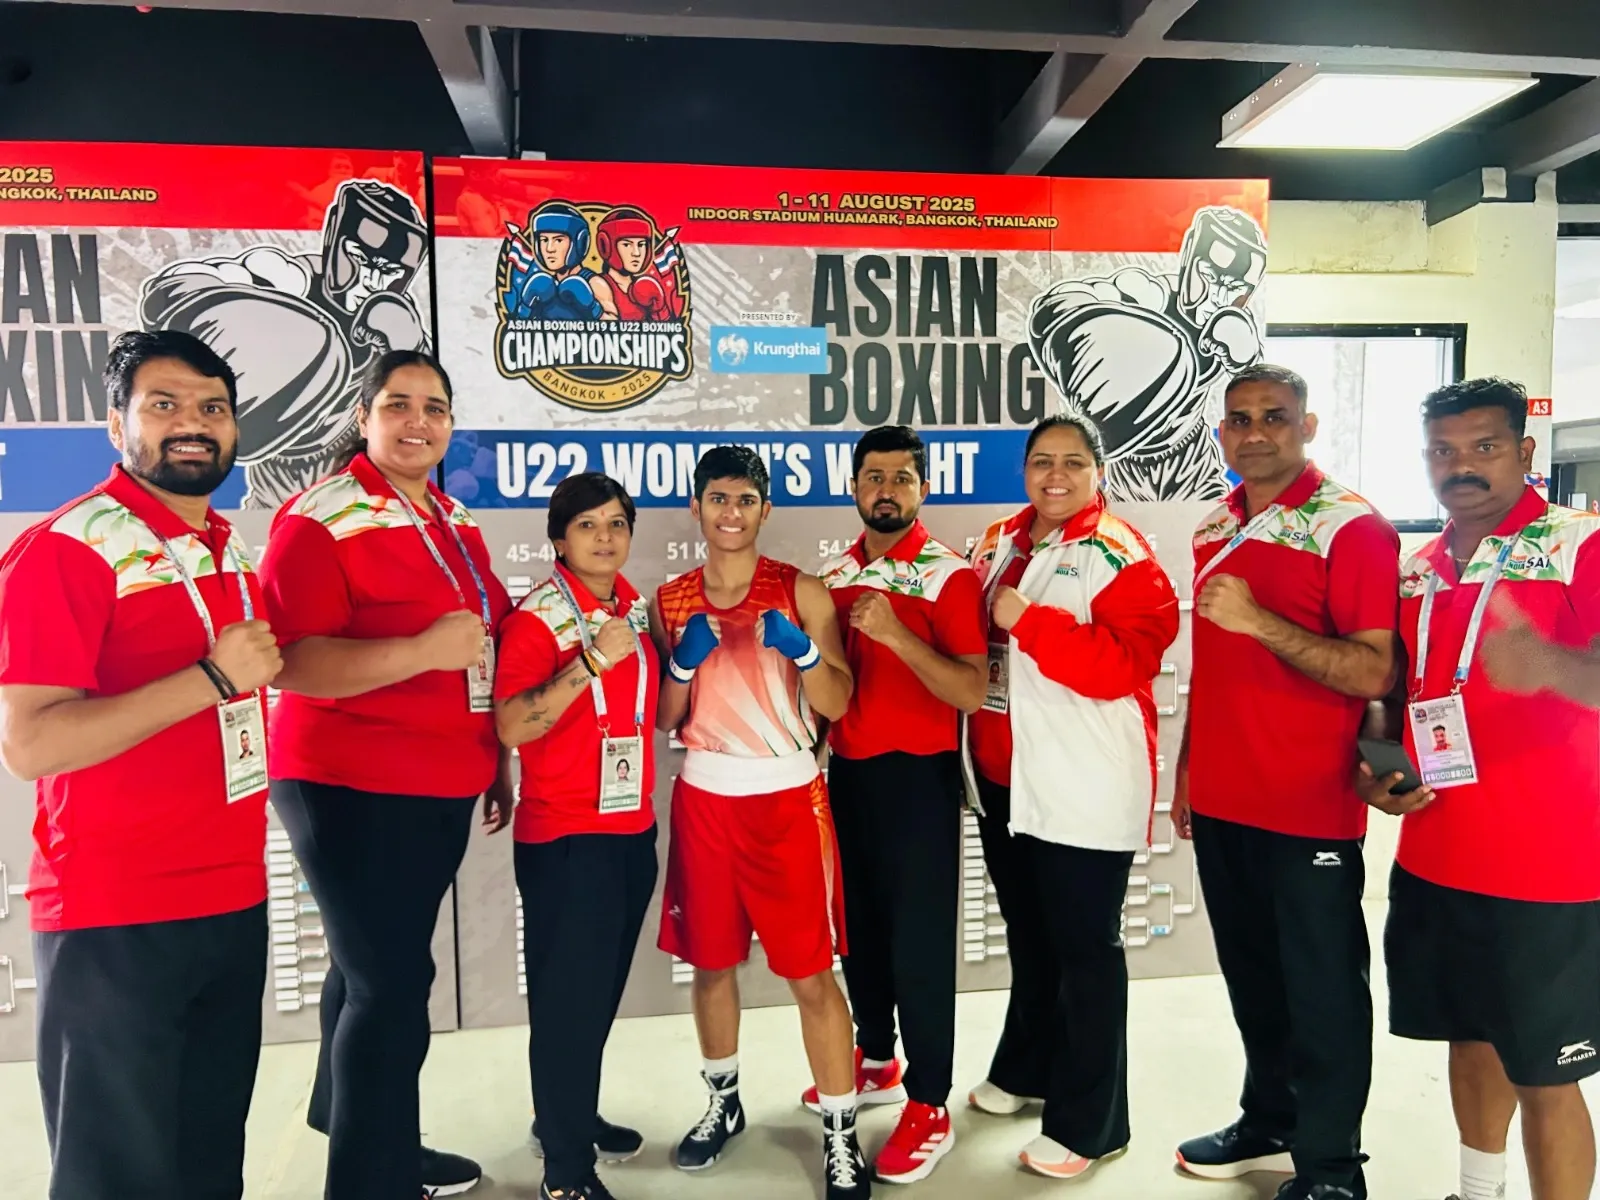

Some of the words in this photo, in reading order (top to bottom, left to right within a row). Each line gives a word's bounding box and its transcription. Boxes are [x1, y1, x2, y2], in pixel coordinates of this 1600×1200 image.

[0, 168, 53, 183] 2025
[66, 188, 157, 201] THAILAND
[778, 192, 788, 207] 1
[808, 193, 829, 208] 11
[840, 194, 925, 210] AUGUST
[930, 197, 975, 211] 2025
[688, 208, 749, 220] INDOOR
[753, 210, 820, 222] STADIUM
[824, 212, 902, 225] HUAMARK,
[906, 214, 982, 227] BANGKOK,
[985, 216, 1058, 228] THAILAND
[2, 234, 101, 323] AN
[809, 254, 998, 337] ASIAN
[508, 321, 541, 331] ASIAN
[544, 322, 584, 331] BOXING
[587, 323, 607, 332] U19
[610, 323, 618, 331] &
[620, 323, 640, 332] U22
[643, 324, 682, 332] BOXING
[742, 313, 784, 321] PRESENTED
[787, 313, 797, 321] BY
[503, 331, 685, 372] CHAMPIONSHIPS
[754, 341, 821, 358] Krungthai
[543, 372, 605, 400] BANGKOK
[622, 372, 651, 396] 2025
[810, 342, 1045, 426] BOXING
[1532, 400, 1549, 415] A3
[496, 442, 588, 498] U22
[602, 442, 811, 497] WOM'S
[825, 441, 979, 495] WHT
[667, 541, 688, 560] 51
[694, 541, 709, 560] K
[818, 539, 841, 557] 54
[1526, 556, 1549, 568] SAI
